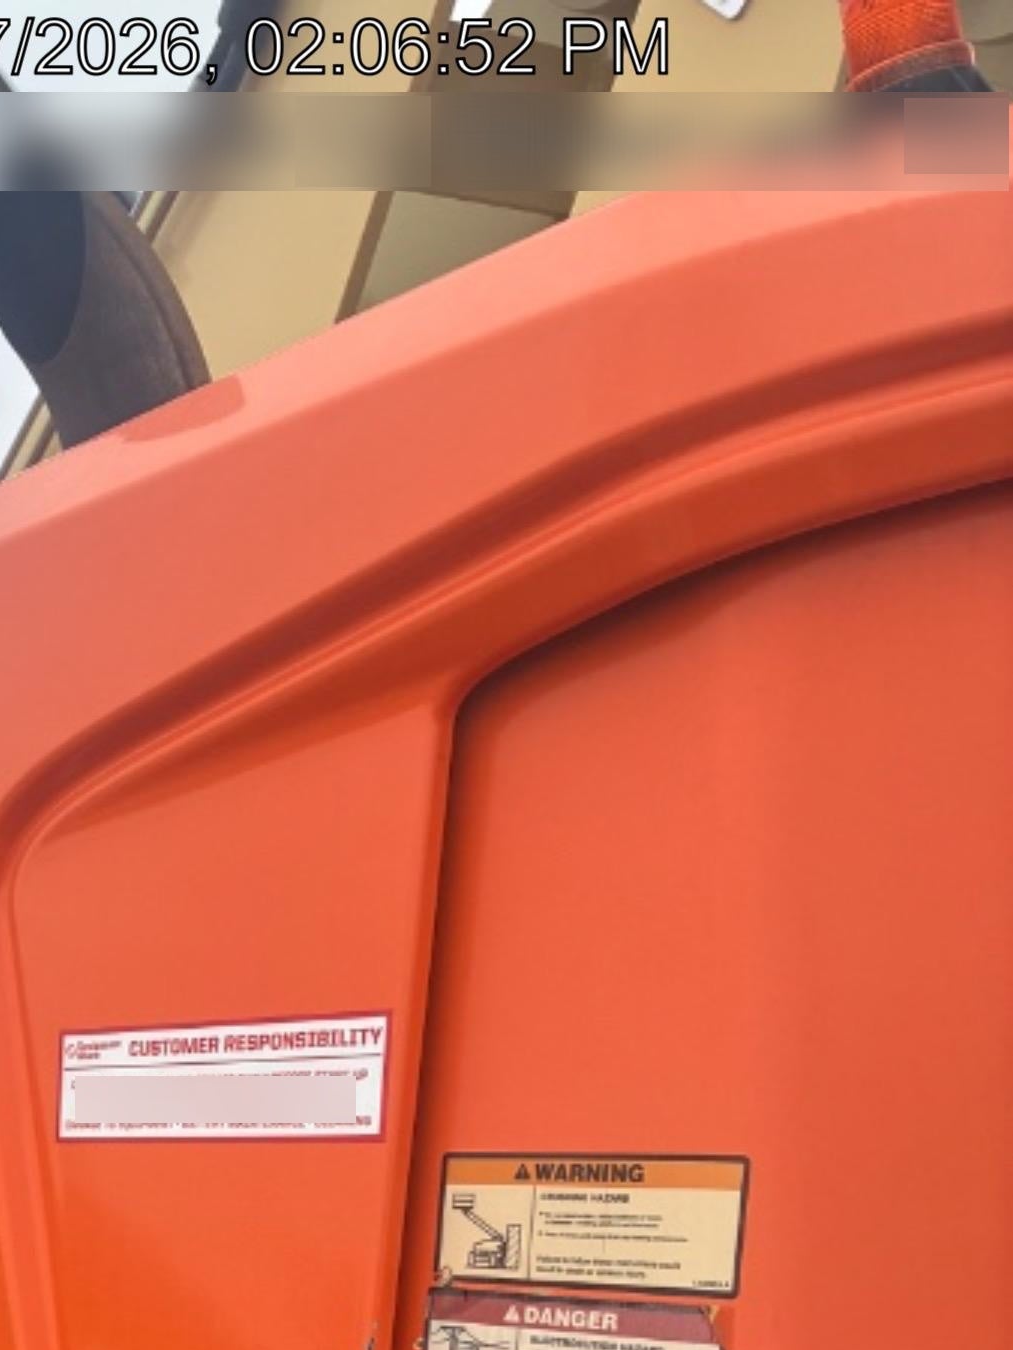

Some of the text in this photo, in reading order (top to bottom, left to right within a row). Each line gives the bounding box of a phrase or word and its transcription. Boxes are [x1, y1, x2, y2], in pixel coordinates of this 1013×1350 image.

[128, 1026, 383, 1057] CUSTOMER RESPONSIBILITY
[535, 1163, 645, 1183] WARNING
[523, 1305, 619, 1332] DANGER
